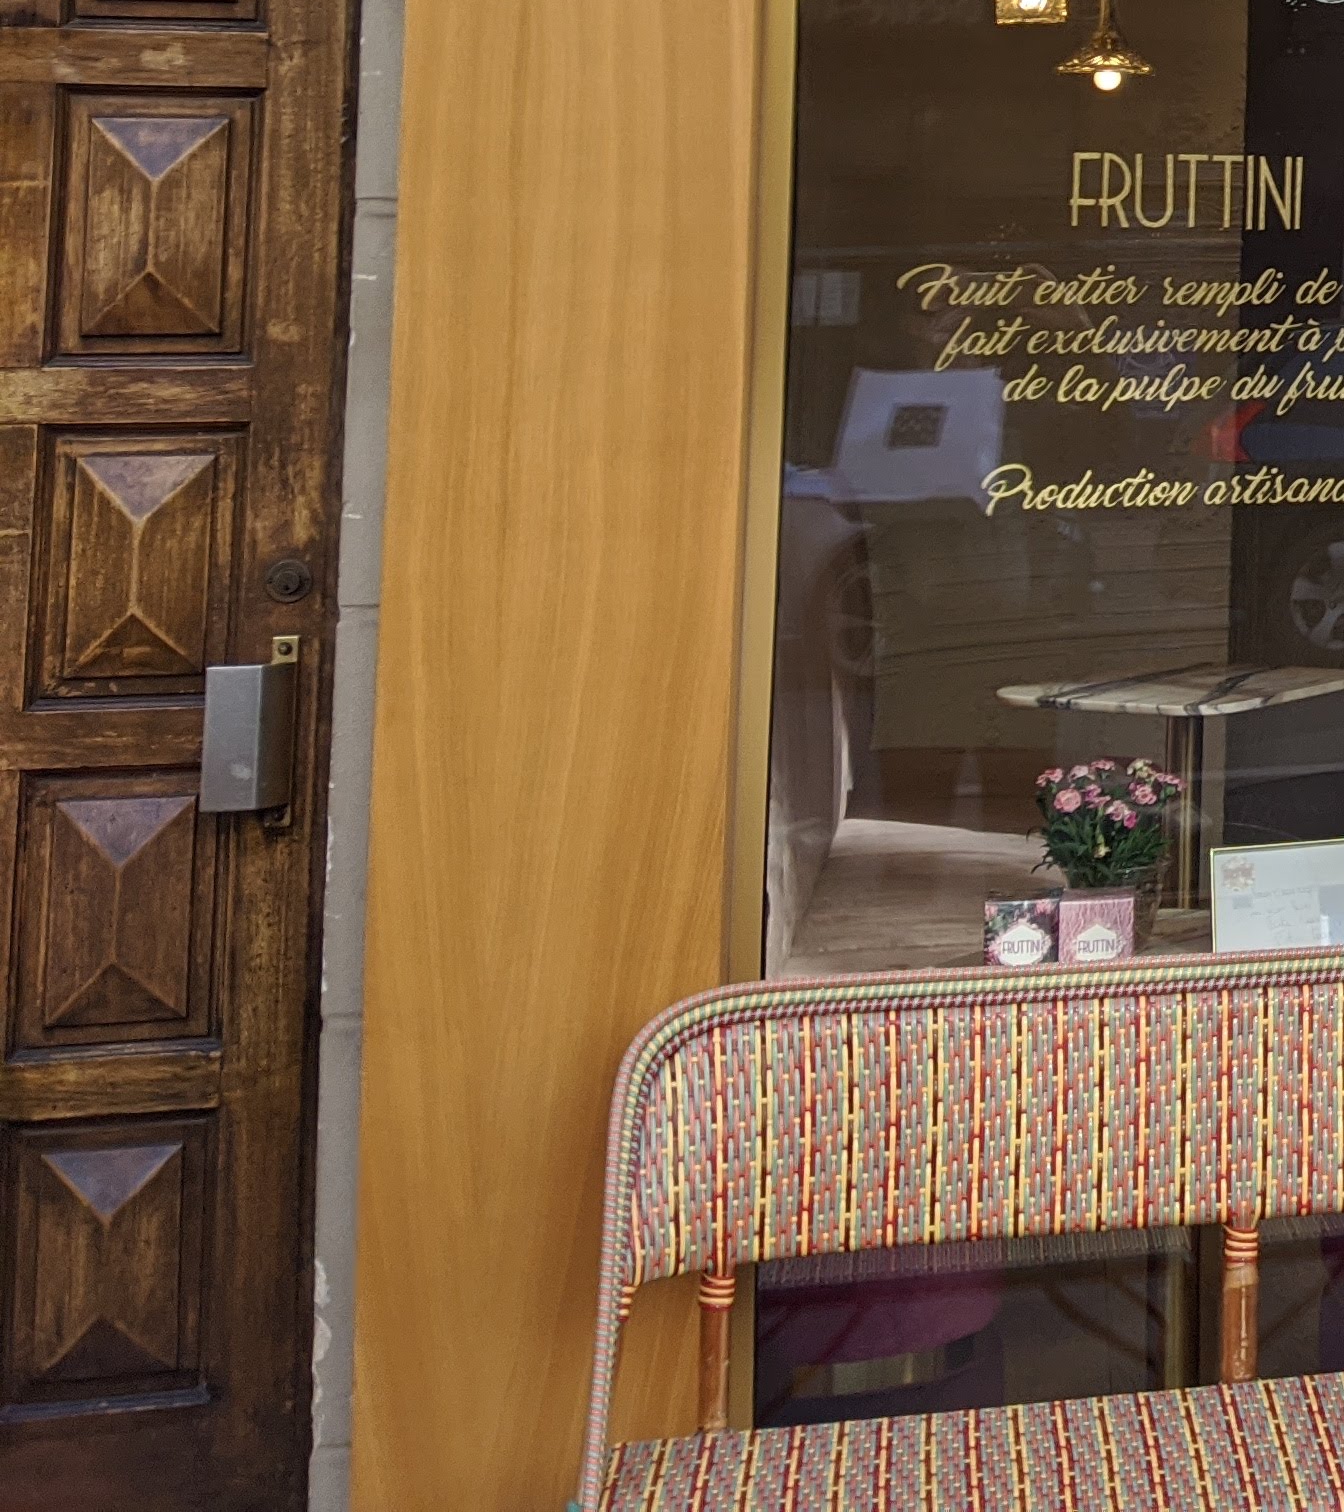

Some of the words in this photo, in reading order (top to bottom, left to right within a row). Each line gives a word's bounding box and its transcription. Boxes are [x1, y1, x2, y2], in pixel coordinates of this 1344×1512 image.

[1069, 152, 1304, 231] FRUTTINI
[896, 263, 1036, 310] Fruit
[1033, 264, 1148, 306] entier
[1162, 268, 1286, 317] rempli
[1295, 267, 1343, 304] de
[934, 316, 1030, 372] fait
[1026, 315, 1303, 356] exclusivement
[1297, 319, 1331, 352] à
[1002, 364, 1054, 402] de
[1056, 364, 1109, 403] la
[1101, 364, 1227, 412] pulpe
[1230, 364, 1284, 401] du
[980, 463, 1198, 517] Production
